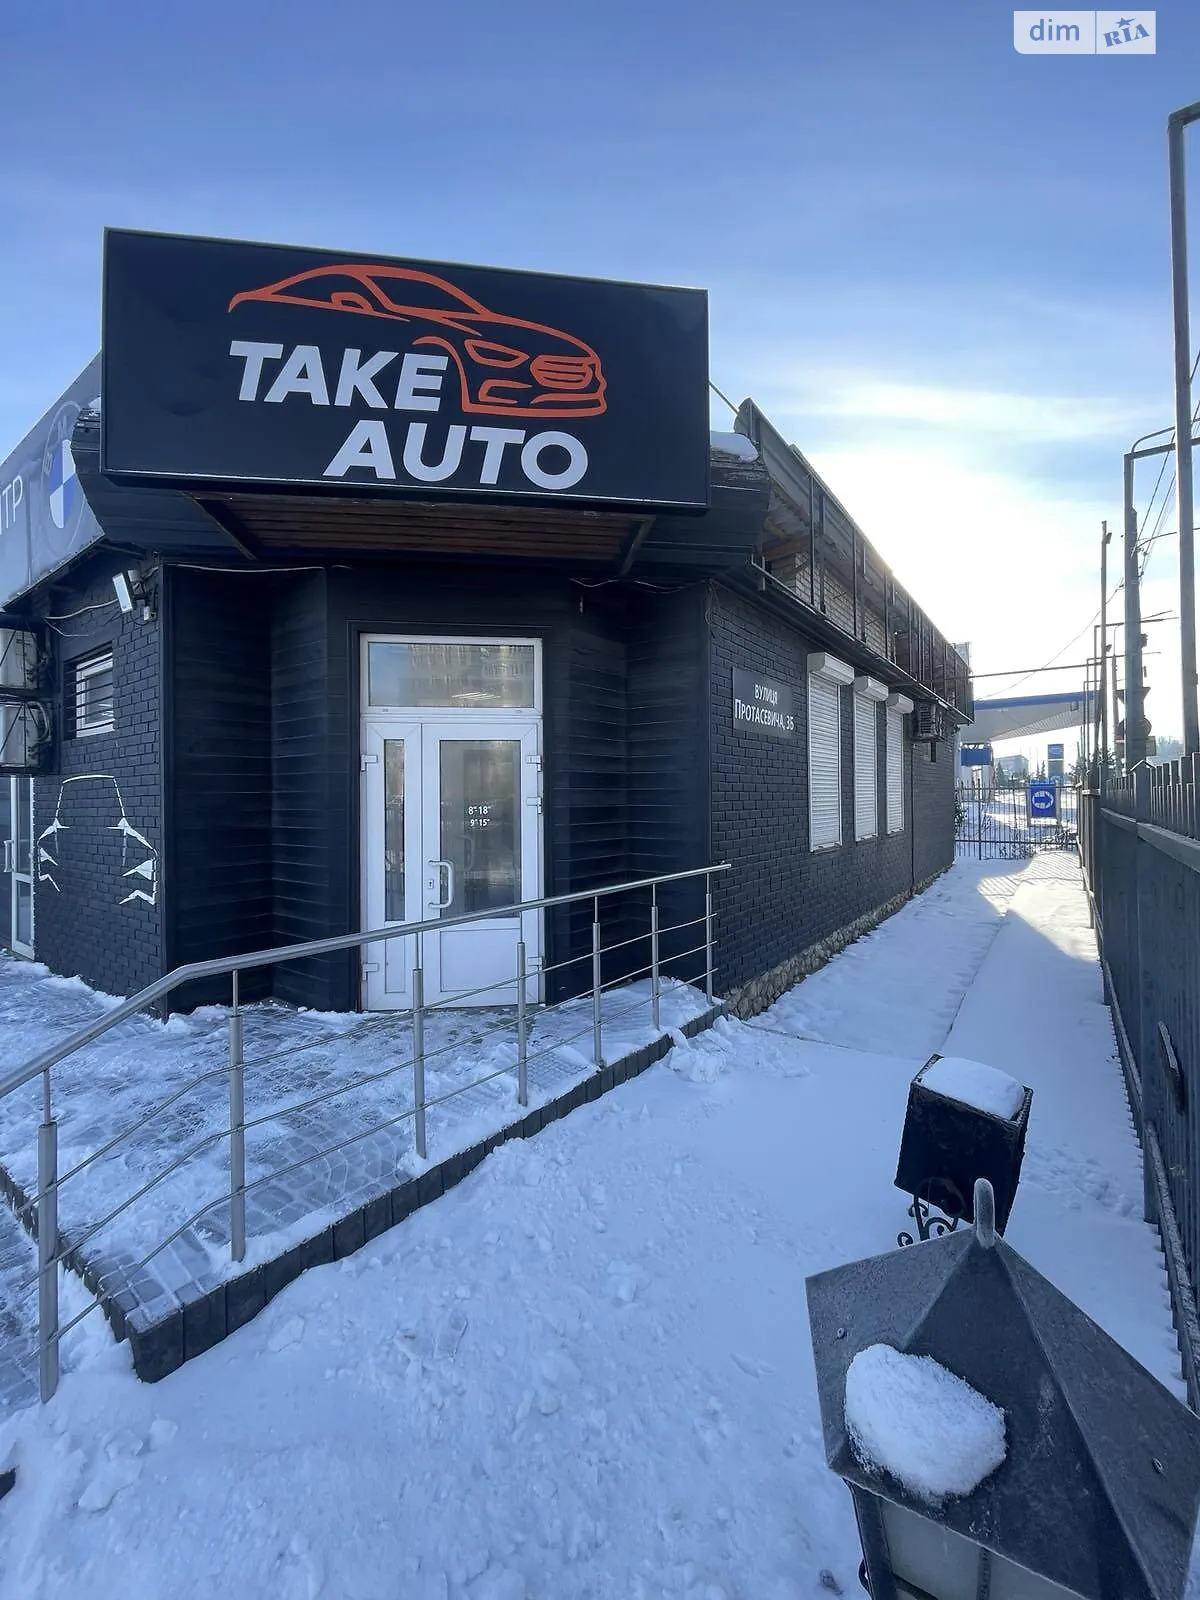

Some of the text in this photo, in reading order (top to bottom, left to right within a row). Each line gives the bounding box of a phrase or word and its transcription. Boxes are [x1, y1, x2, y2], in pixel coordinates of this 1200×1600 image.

[229, 340, 449, 412] TAKE
[322, 419, 589, 490] AUTO
[0, 475, 23, 535] ТР
